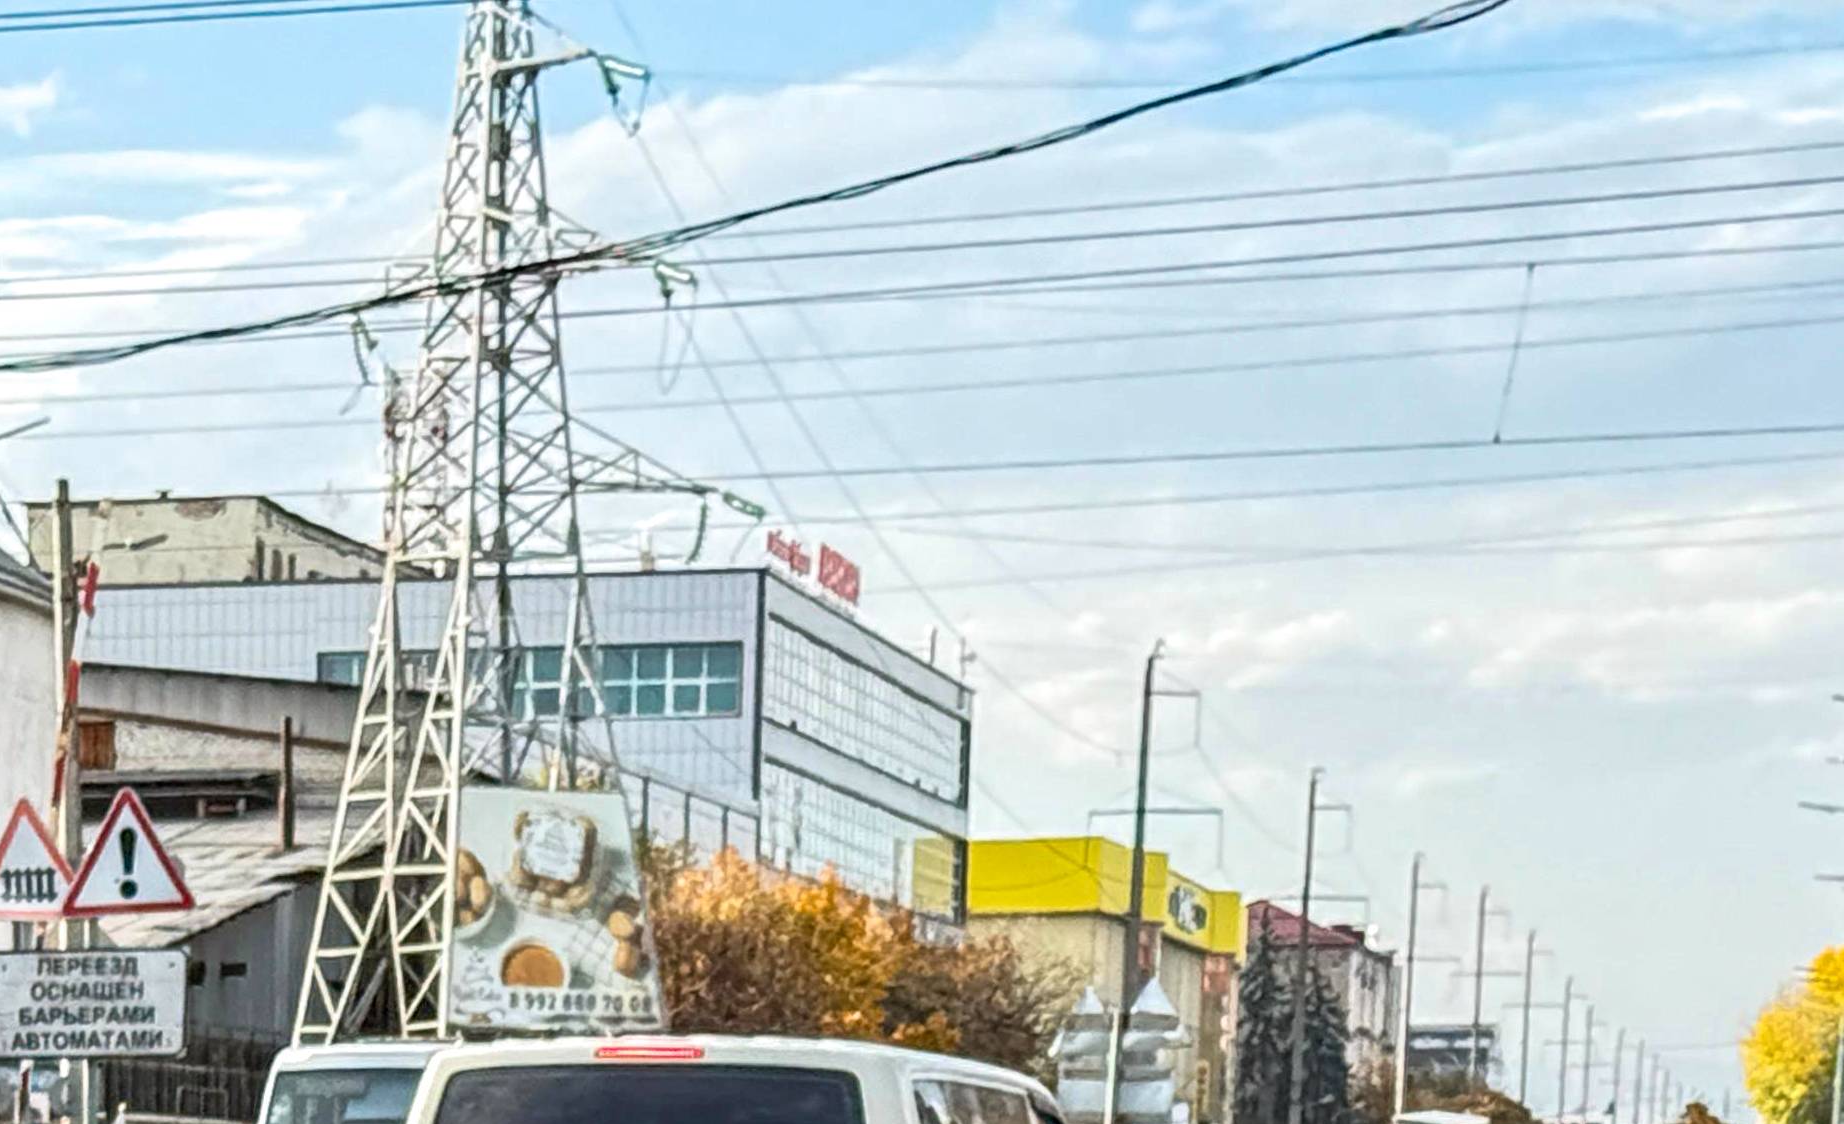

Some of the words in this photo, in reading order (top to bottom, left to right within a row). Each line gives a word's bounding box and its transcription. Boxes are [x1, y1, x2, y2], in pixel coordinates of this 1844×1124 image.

[37, 956, 139, 976] ПЕРЕЕЗД
[30, 982, 145, 1002] ОСНАЩЕН
[18, 1006, 156, 1026] БАРЬЕРАМИ
[11, 1031, 164, 1051] АВТОМАТАМИ
